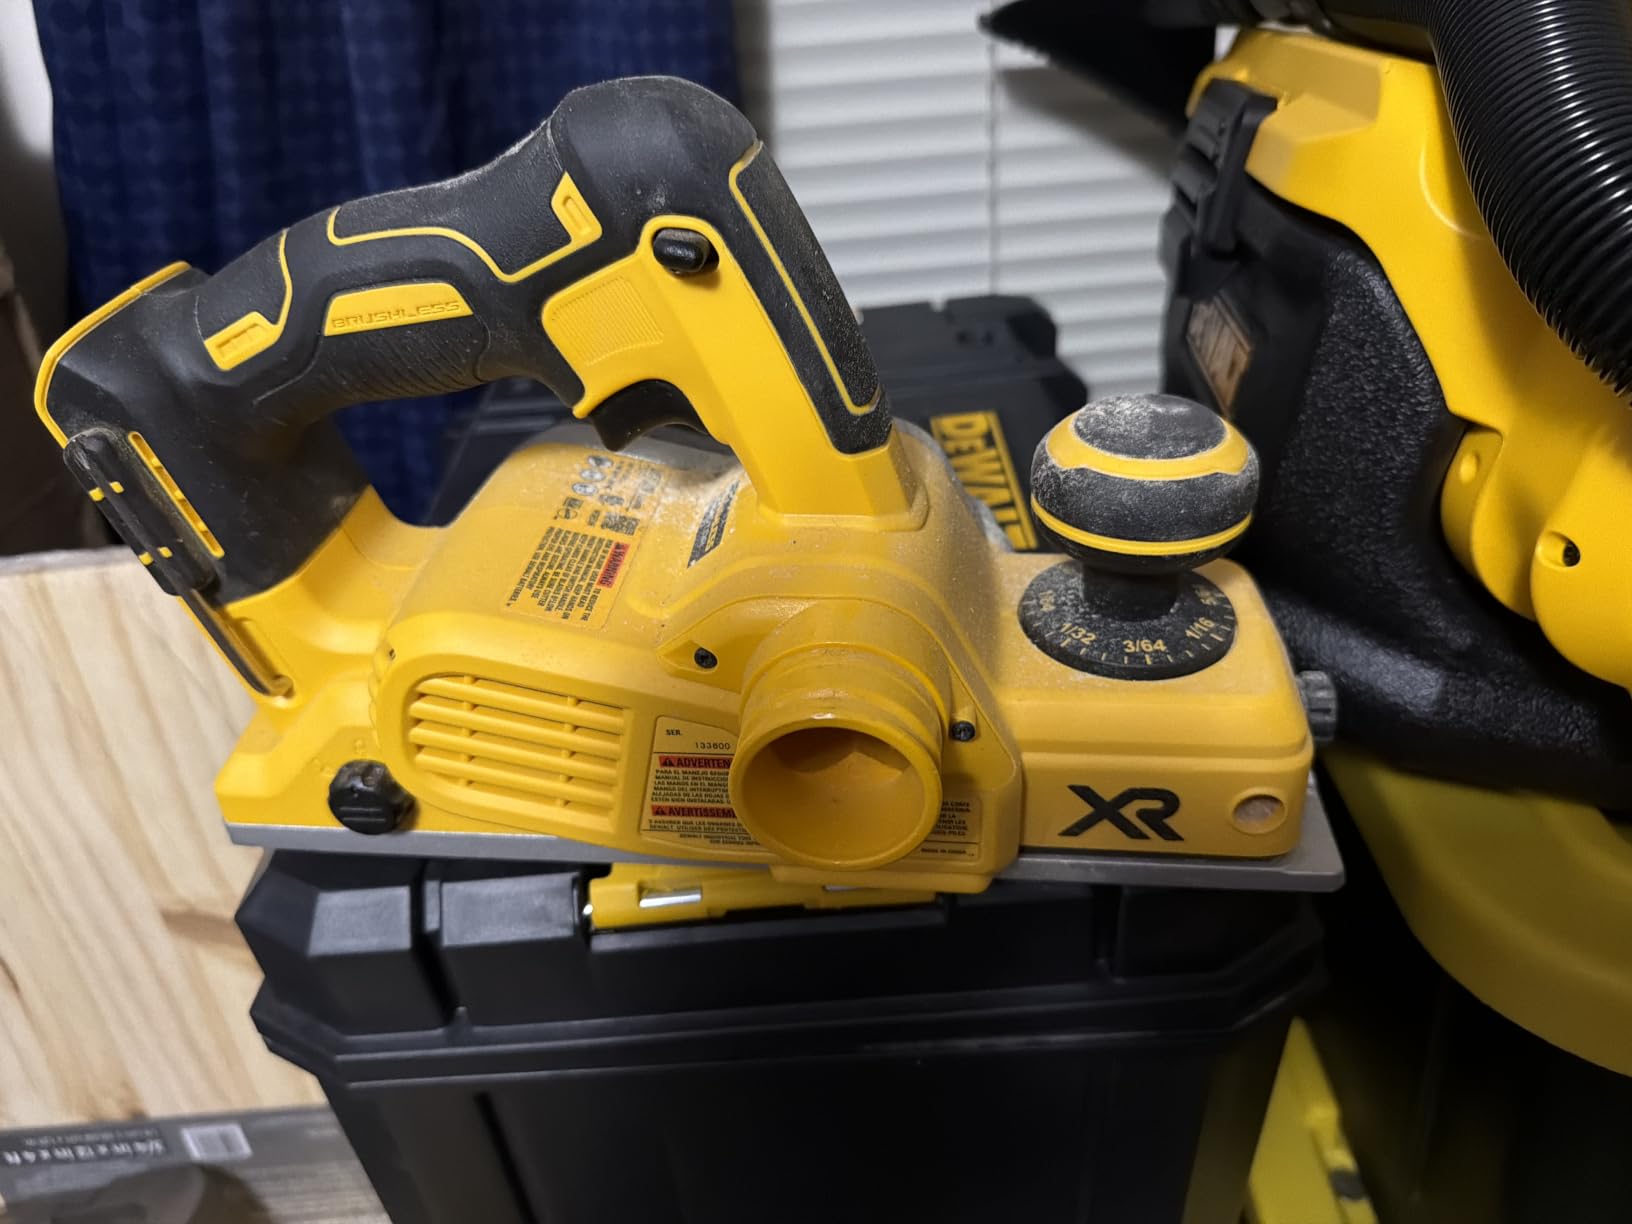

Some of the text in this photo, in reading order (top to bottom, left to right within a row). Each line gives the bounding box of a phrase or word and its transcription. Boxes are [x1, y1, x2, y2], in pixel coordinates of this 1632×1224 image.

[332, 301, 459, 328] BRUSHLESS
[598, 549, 625, 586] WARNING
[1061, 623, 1096, 645] 1/32
[1185, 617, 1216, 640] 1/16
[1122, 639, 1167, 653] 3/64
[1057, 784, 1185, 841] XR
